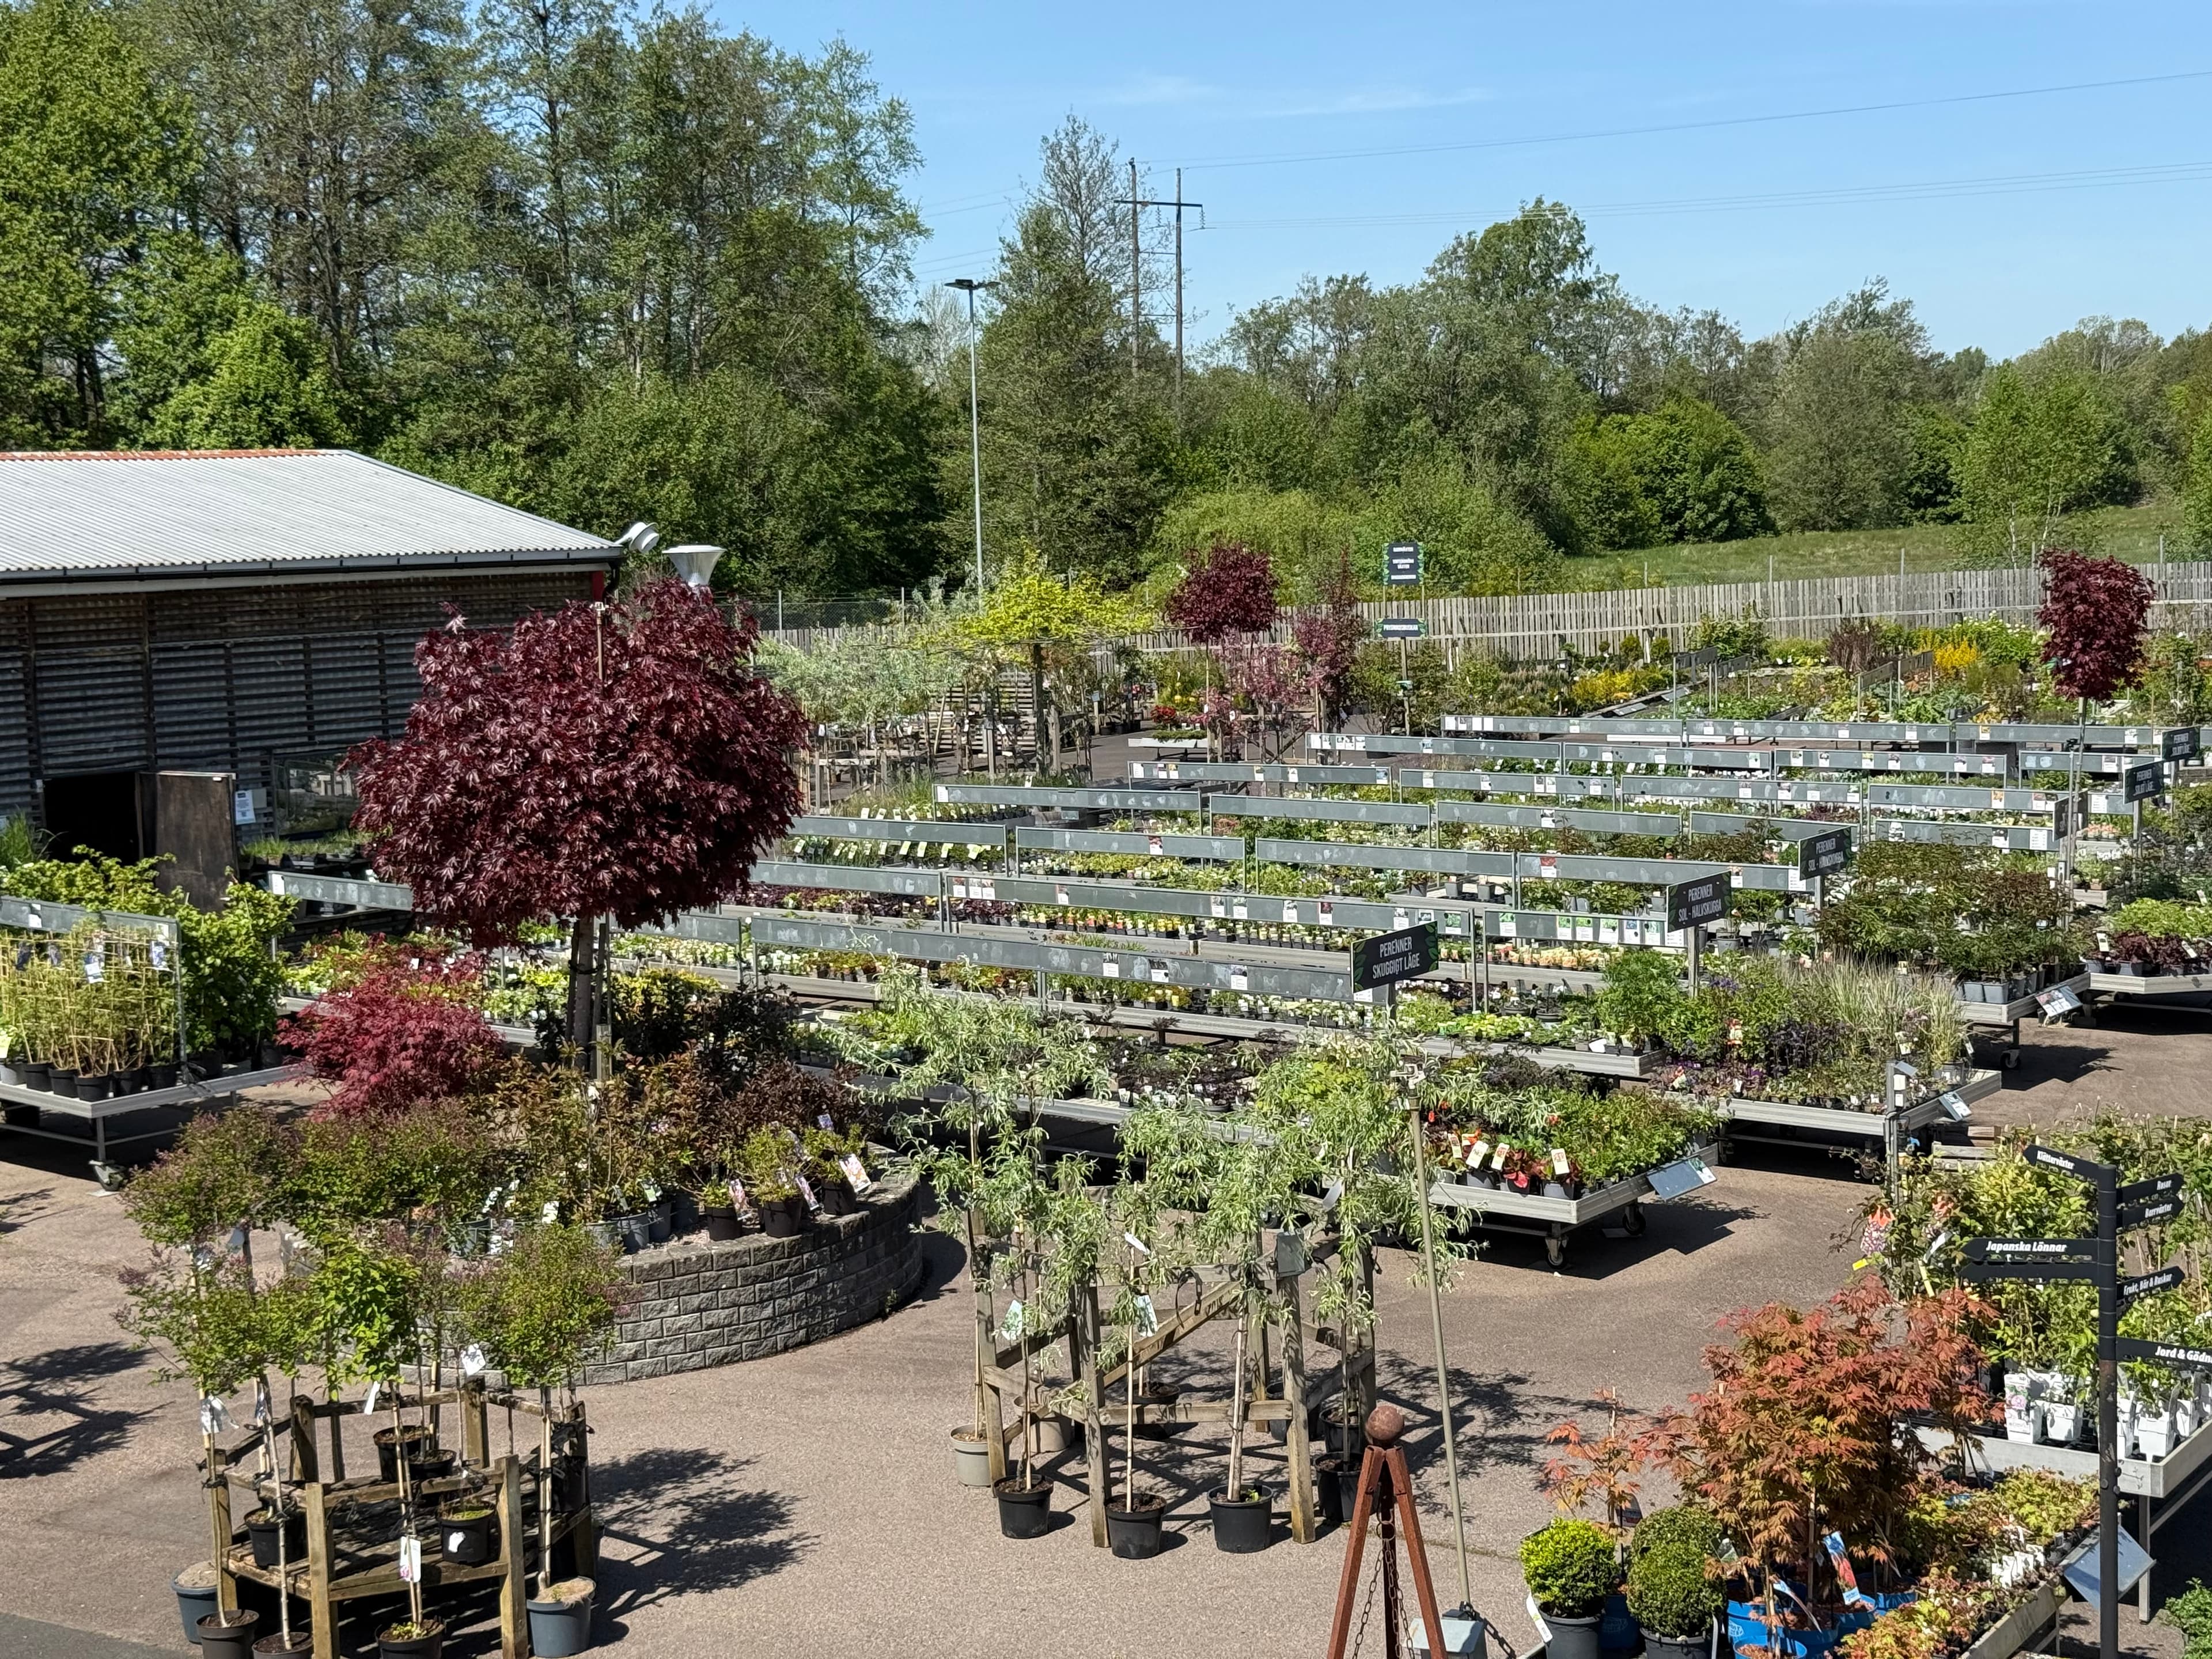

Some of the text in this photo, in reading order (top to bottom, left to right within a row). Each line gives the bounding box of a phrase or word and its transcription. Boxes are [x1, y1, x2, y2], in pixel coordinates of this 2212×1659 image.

[1688, 884, 1713, 902] PERENNER
[1678, 907, 1688, 922] SOL
[1692, 899, 1722, 919] HALVSKUGGA
[1380, 936, 1412, 958] PERENNER
[1373, 953, 1420, 979] SKUGGIGT LÄGE
[2036, 1150, 2075, 1170] Klätterväxter
[2156, 1180, 2172, 1191] Rosor
[2145, 1203, 2173, 1218] Barrväxter
[1986, 1241, 2067, 1253] Japanska Lönnar
[2123, 1272, 2173, 1296] Frukt, Bär & Buskar
[2155, 1346, 2212, 1363] Jord & Gödn
